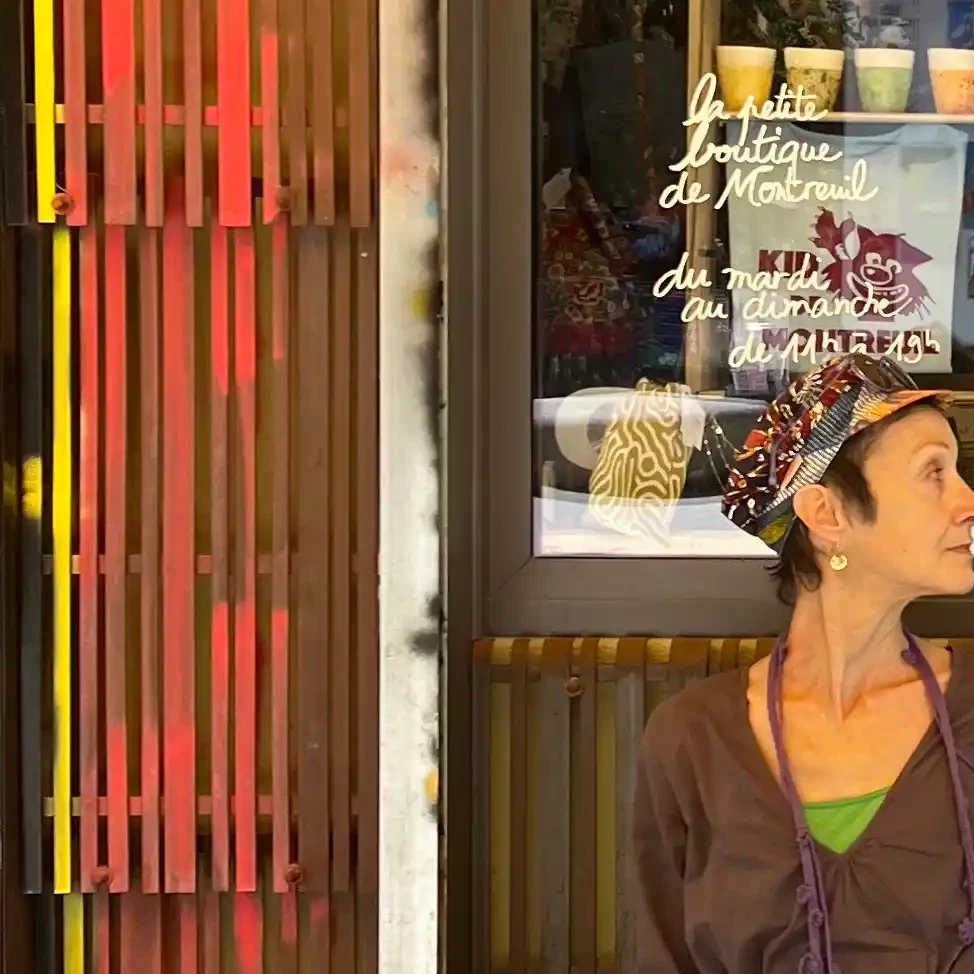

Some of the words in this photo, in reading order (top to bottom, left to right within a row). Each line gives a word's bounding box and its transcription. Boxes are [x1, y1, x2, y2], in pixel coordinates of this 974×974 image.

[736, 82, 829, 147] petite
[668, 120, 844, 182] boutique
[658, 171, 711, 209] de
[713, 158, 879, 210] Montreuil
[652, 252, 712, 298] du
[721, 252, 832, 291] mardi
[680, 296, 729, 323] au
[742, 282, 912, 319] dimanche
[728, 332, 773, 369] de
[780, 331, 840, 365] 11h
[884, 328, 941, 364] 19h
